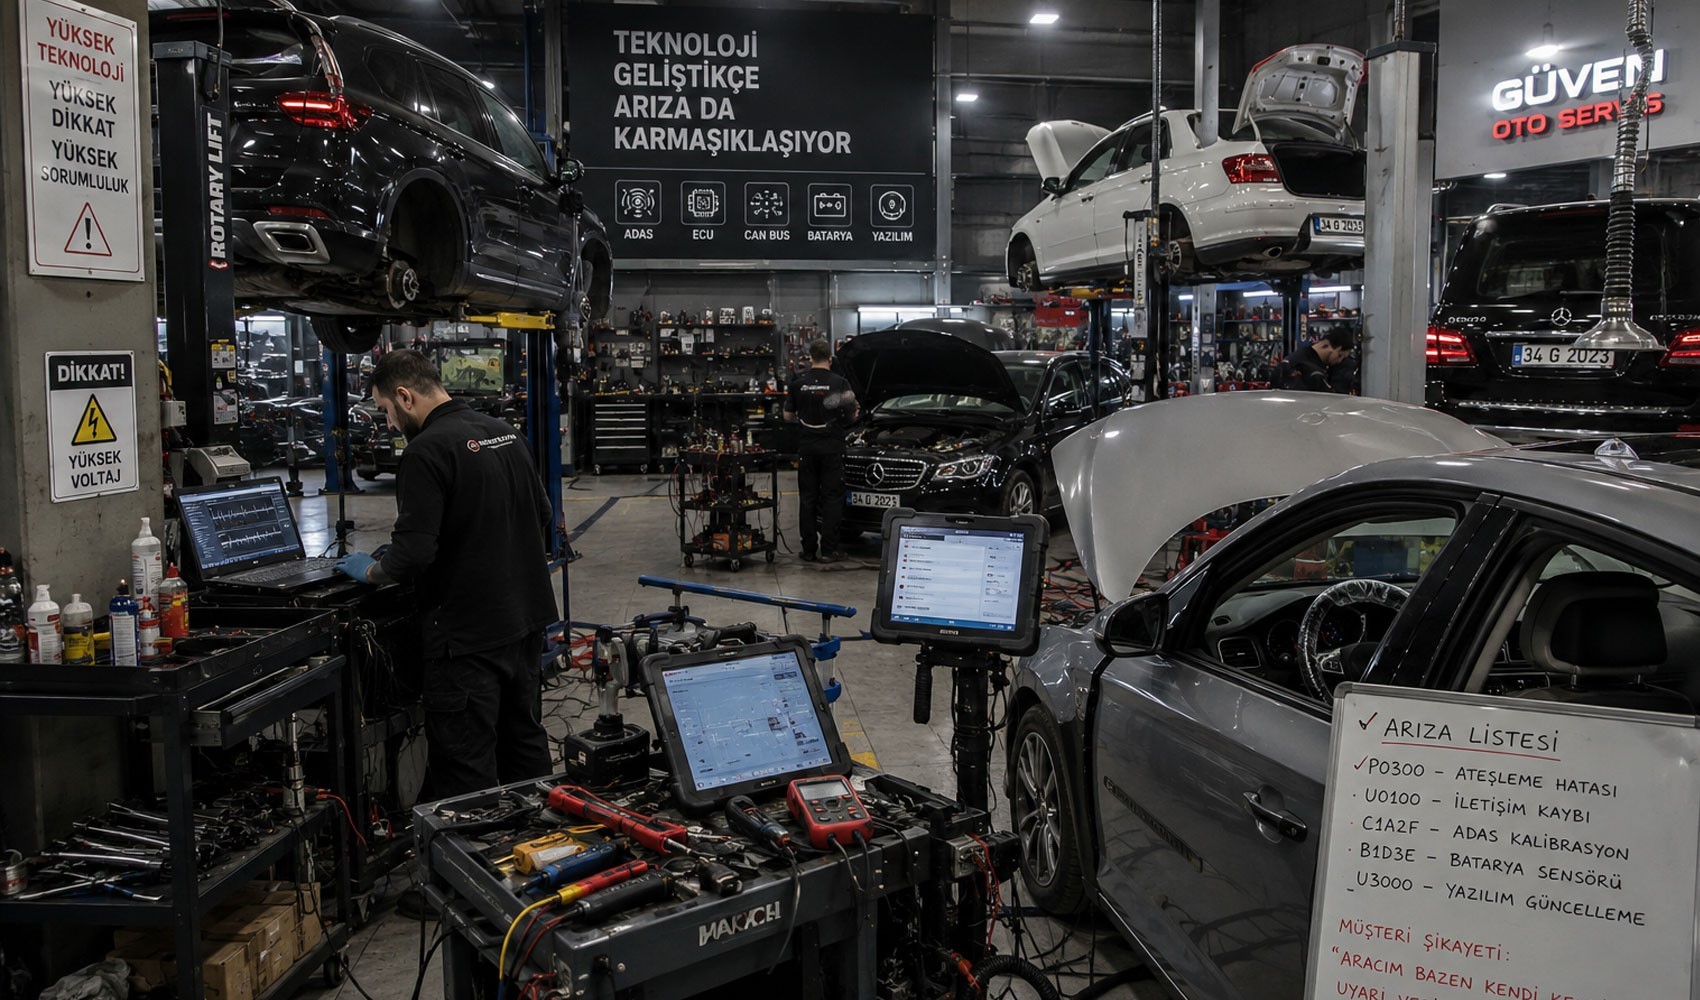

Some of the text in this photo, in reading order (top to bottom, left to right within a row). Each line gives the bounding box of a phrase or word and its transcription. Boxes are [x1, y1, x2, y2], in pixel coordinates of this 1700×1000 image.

[46, 17, 115, 55] YÜKSEK
[613, 30, 758, 59] TEKNOLOJİ
[37, 42, 124, 82] TEKNOLOJİ
[613, 58, 760, 94] GELİŞTİKÇE
[1492, 49, 1665, 111] GÜVEN
[49, 80, 117, 115] YÜKSEK
[613, 95, 735, 121] ARIZA DA
[52, 107, 115, 139] DİKKAT
[1492, 93, 1664, 140] OTO SERVS
[51, 139, 118, 170] YÜKSEK
[614, 126, 852, 158] KARMAŞIKLAŞIYOR
[41, 165, 129, 194] SORUMLULUK
[207, 112, 227, 259] ROTARY LIFT
[623, 228, 654, 240] ADAS
[692, 229, 714, 241] ECU
[744, 229, 790, 241] CAN BUS
[807, 230, 853, 242] BATARYA
[872, 230, 913, 242] YAZILIM
[57, 360, 126, 383] DİKKAT!
[1523, 347, 1610, 364] 34 G 2023
[68, 450, 122, 470] YÜKSEK
[71, 469, 121, 489] VOLTAJ
[1384, 718, 1559, 752] ARIZA LİSTESİ
[1369, 758, 1424, 777] P0300
[1456, 767, 1543, 789] ATEŞLEME
[1556, 779, 1617, 798] HATASI
[1365, 789, 1420, 806] U0100
[1455, 792, 1526, 816] İLETİŞİM
[1538, 805, 1590, 823] KAYBI
[1362, 816, 1420, 834] C1A2F
[1453, 826, 1498, 842] ADAS
[1511, 832, 1629, 860] KALİBRASYON
[1360, 843, 1415, 862] B1D3E
[1451, 853, 1524, 876] BATARYA
[1538, 866, 1622, 890] SENSÖRÜ
[1357, 872, 1412, 891] U3000
[1446, 883, 1514, 906] YAZILIM
[1526, 896, 1645, 926] GÜNCELLEME
[1339, 919, 1411, 944] MÜŞTERİ
[1416, 966, 1472, 989] BAZEN
[1485, 979, 1538, 1000] KENDİ
